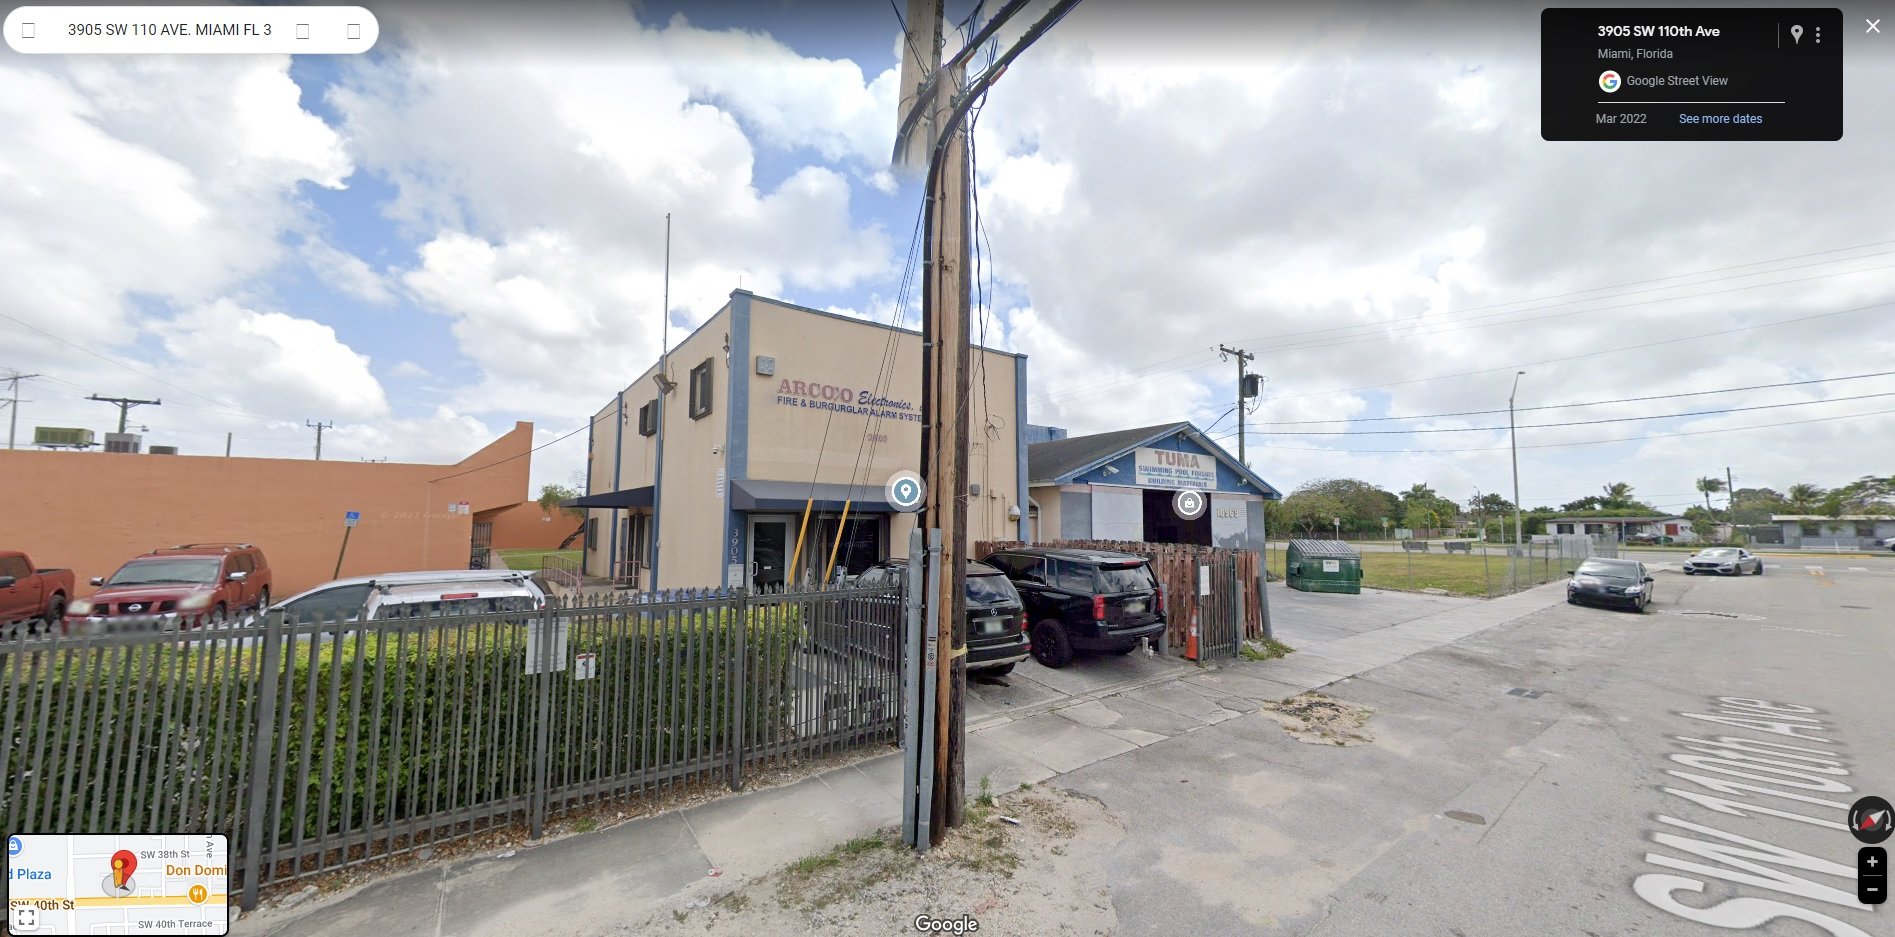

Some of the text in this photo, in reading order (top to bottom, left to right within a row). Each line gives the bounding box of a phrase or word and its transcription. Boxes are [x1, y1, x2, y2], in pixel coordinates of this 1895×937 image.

[777, 396, 798, 406] FIRE
[800, 398, 807, 408] &
[870, 408, 898, 420] ALARM
[898, 412, 923, 422] SYSTE
[1154, 450, 1200, 469] TUMA
[1138, 465, 1173, 475] SWIMMING
[1174, 468, 1190, 477] POOL
[1147, 477, 1208, 488] BUILDING MATERIALS
[730, 528, 739, 564] 3905
